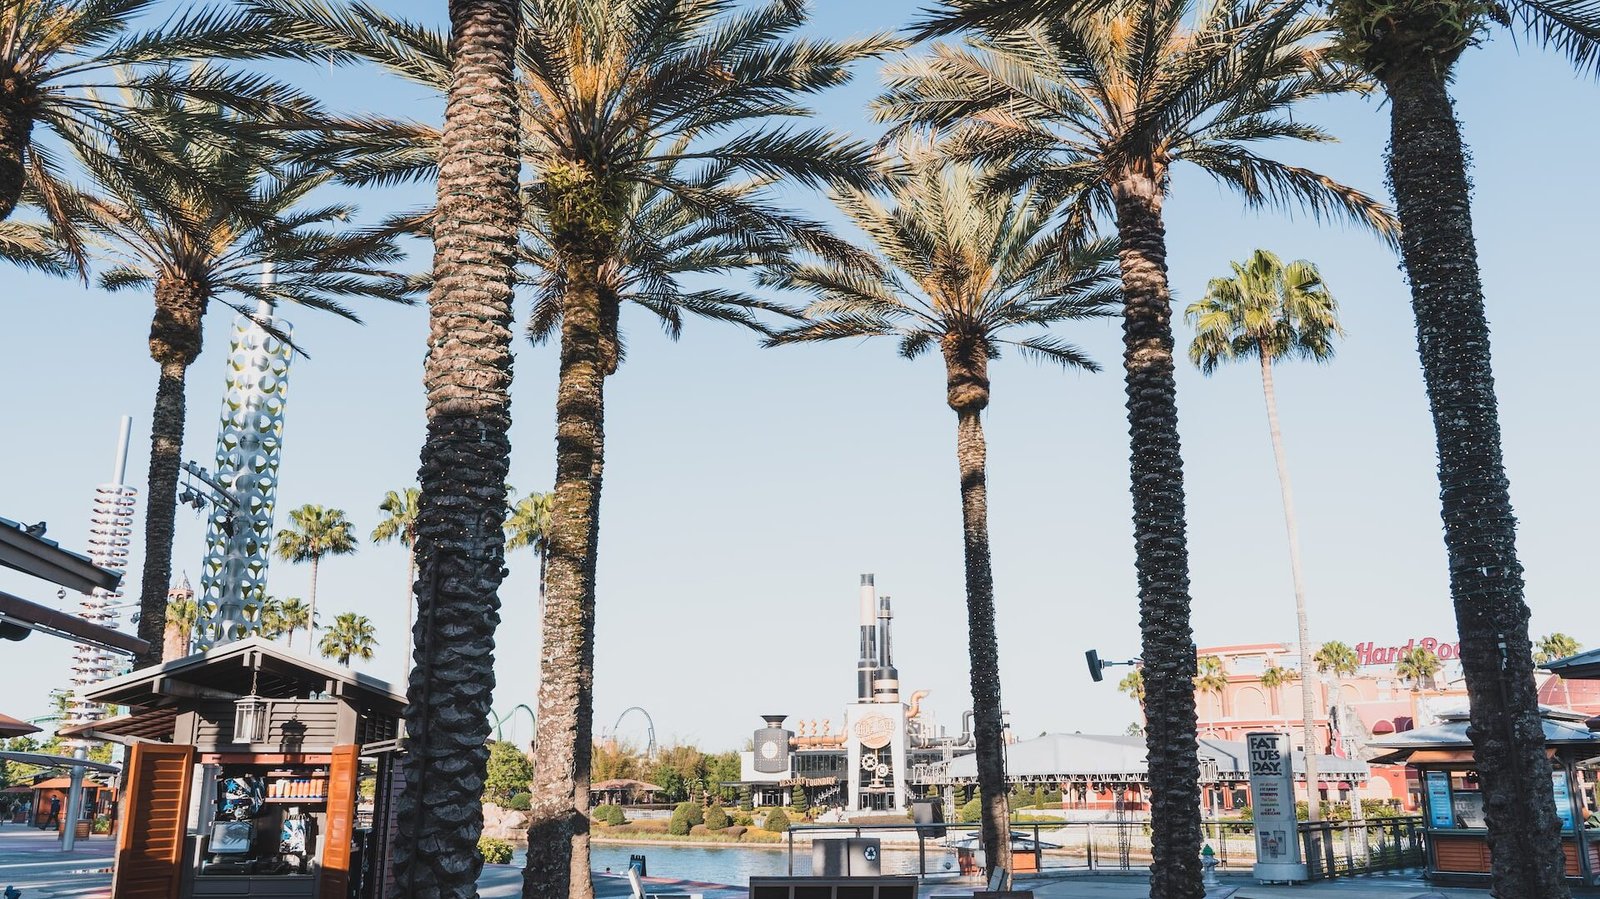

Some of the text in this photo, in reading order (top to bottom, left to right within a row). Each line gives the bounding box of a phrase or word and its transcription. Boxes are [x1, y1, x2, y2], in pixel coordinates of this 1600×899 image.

[1356, 639, 1414, 665] Hard
[1250, 737, 1279, 749] FAT
[1251, 750, 1280, 760] TUES
[806, 775, 837, 787] FOUNDRY
